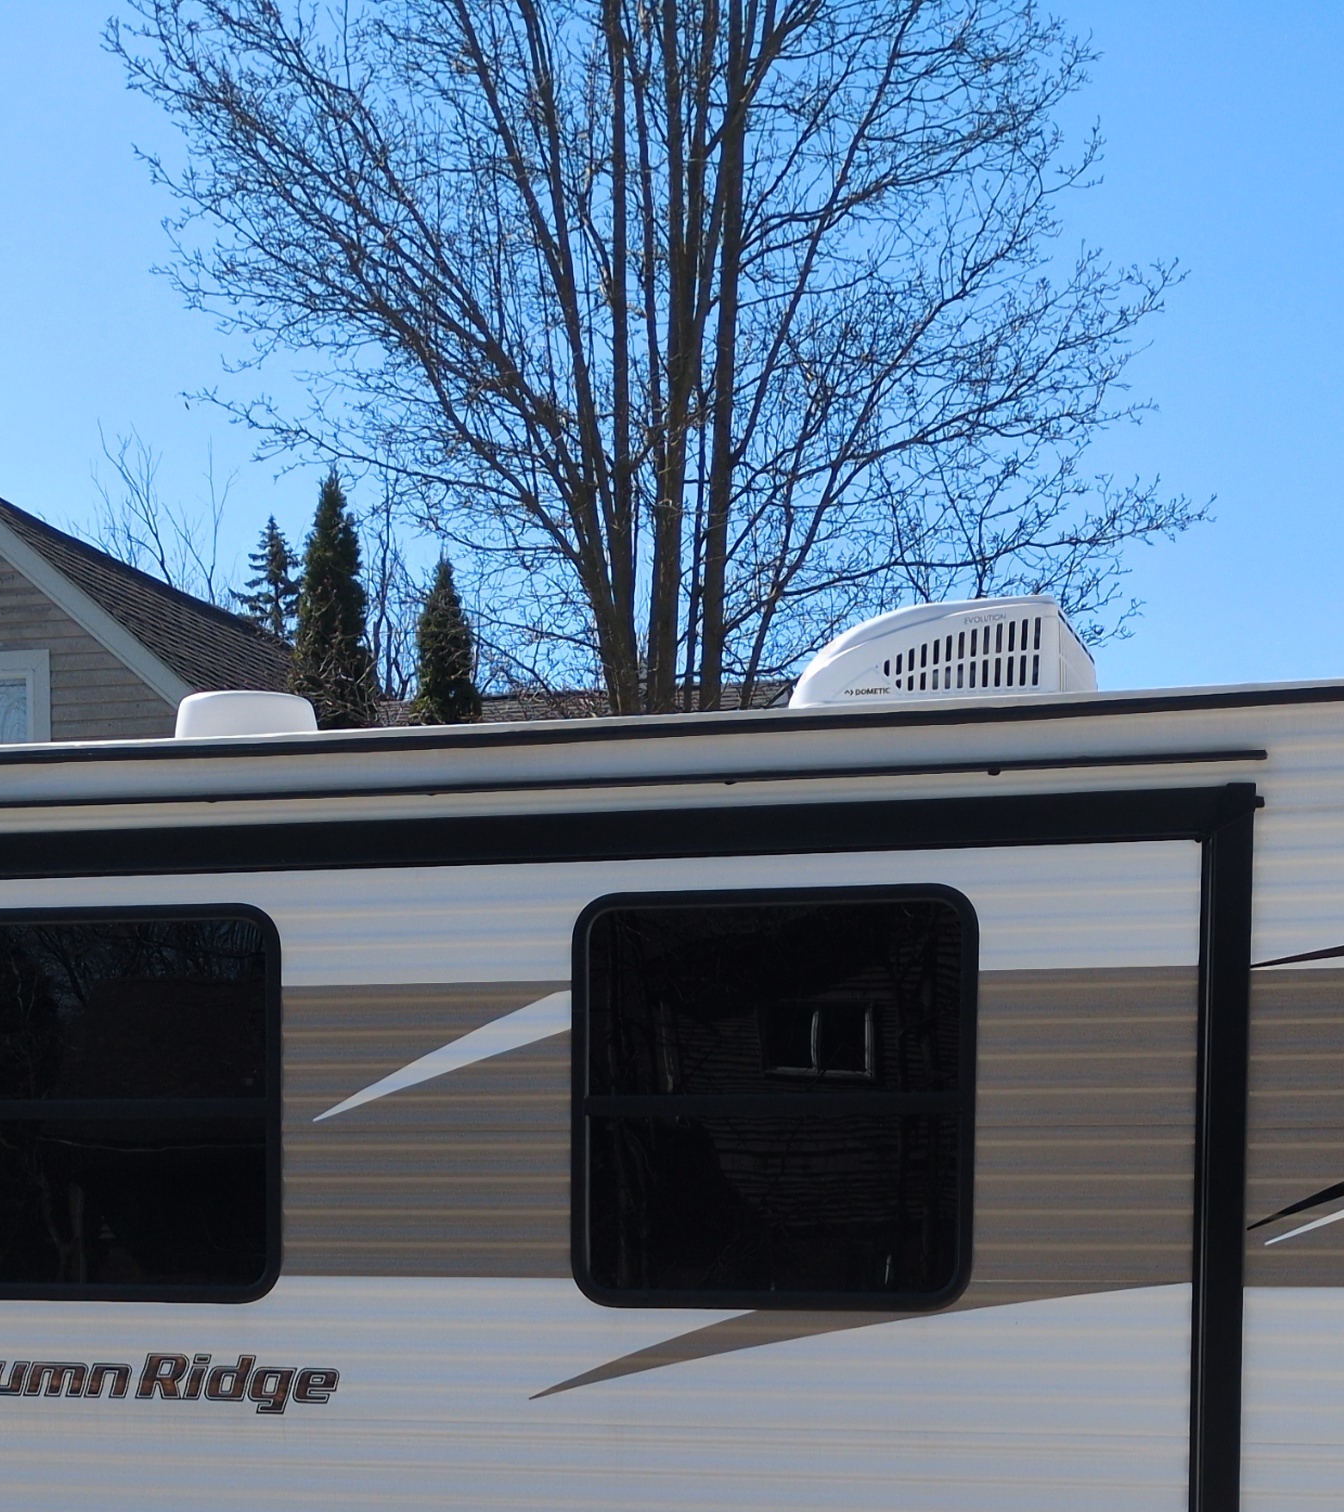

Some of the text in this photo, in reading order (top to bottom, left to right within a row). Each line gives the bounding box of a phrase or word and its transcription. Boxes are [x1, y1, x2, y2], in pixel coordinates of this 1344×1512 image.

[964, 613, 1006, 624] EVOLUTION
[855, 687, 890, 696] DOMETIC
[134, 1352, 340, 1415] Ridge
